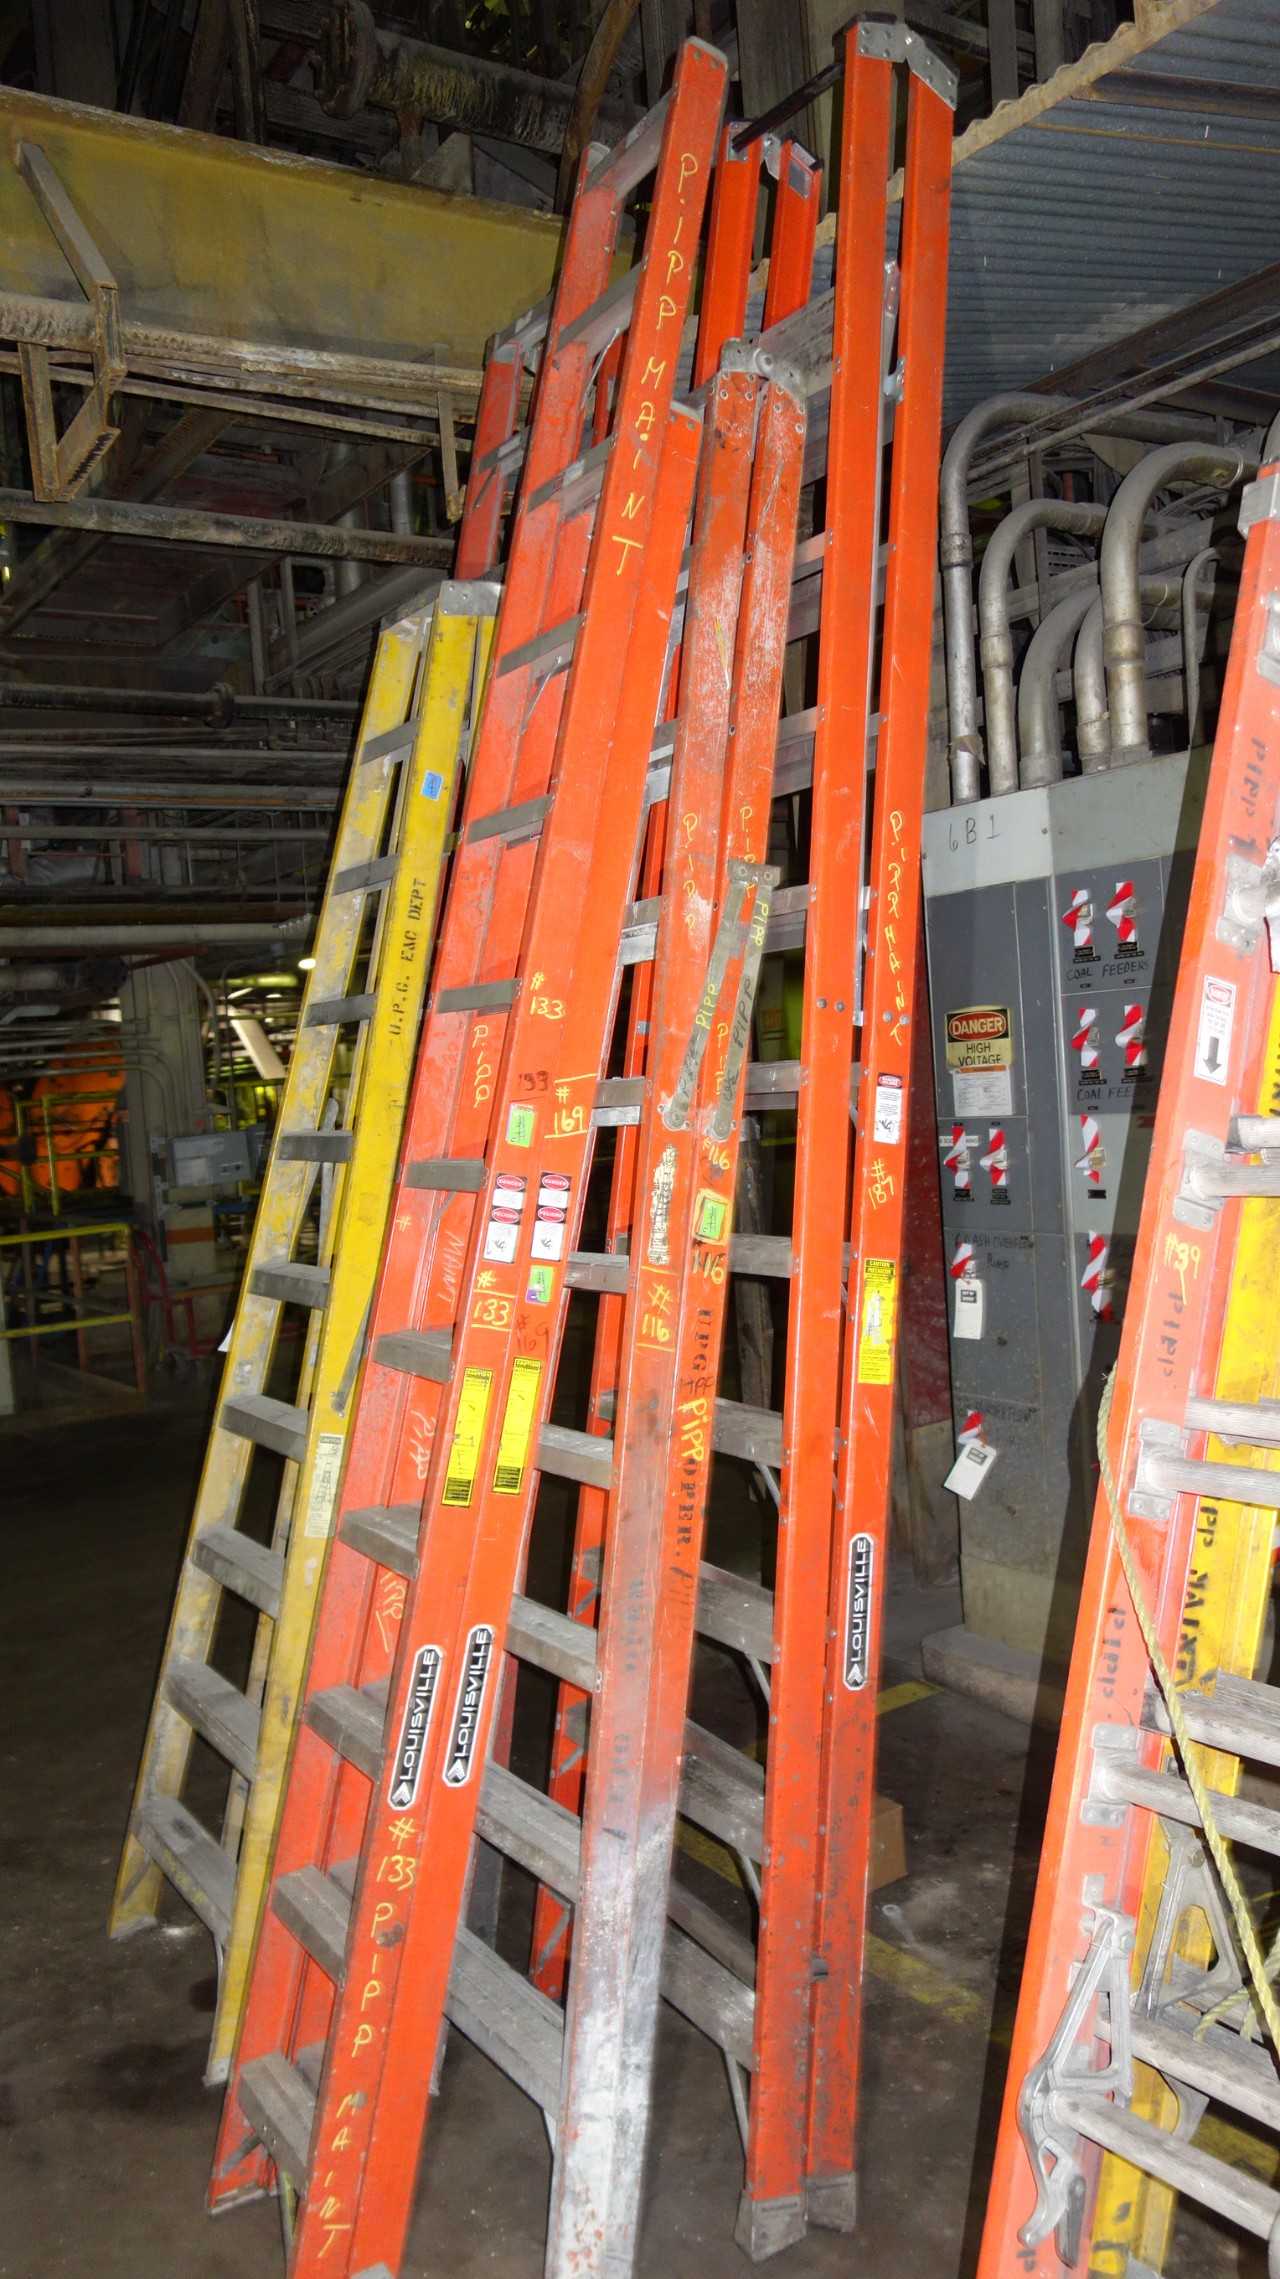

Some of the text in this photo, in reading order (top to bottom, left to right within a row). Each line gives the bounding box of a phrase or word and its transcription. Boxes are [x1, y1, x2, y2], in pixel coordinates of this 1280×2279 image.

[407, 877, 427, 921] DEPT
[1066, 966, 1092, 981] COAL
[529, 997, 566, 1020] 133
[952, 1018, 1003, 1035] DANGER
[958, 1055, 1001, 1066] VOLTAGE
[966, 1042, 991, 1053] HIGH
[553, 1107, 584, 1135] 169
[868, 1175, 895, 1211] 187
[473, 1298, 510, 1326] 133
[641, 1313, 671, 1343] 116
[850, 1540, 867, 1662] LOUISVILLE
[454, 1629, 489, 1758] LOUISVILLE
[400, 1650, 436, 1781] LOUISVILLE
[376, 1855, 417, 1891] 133
